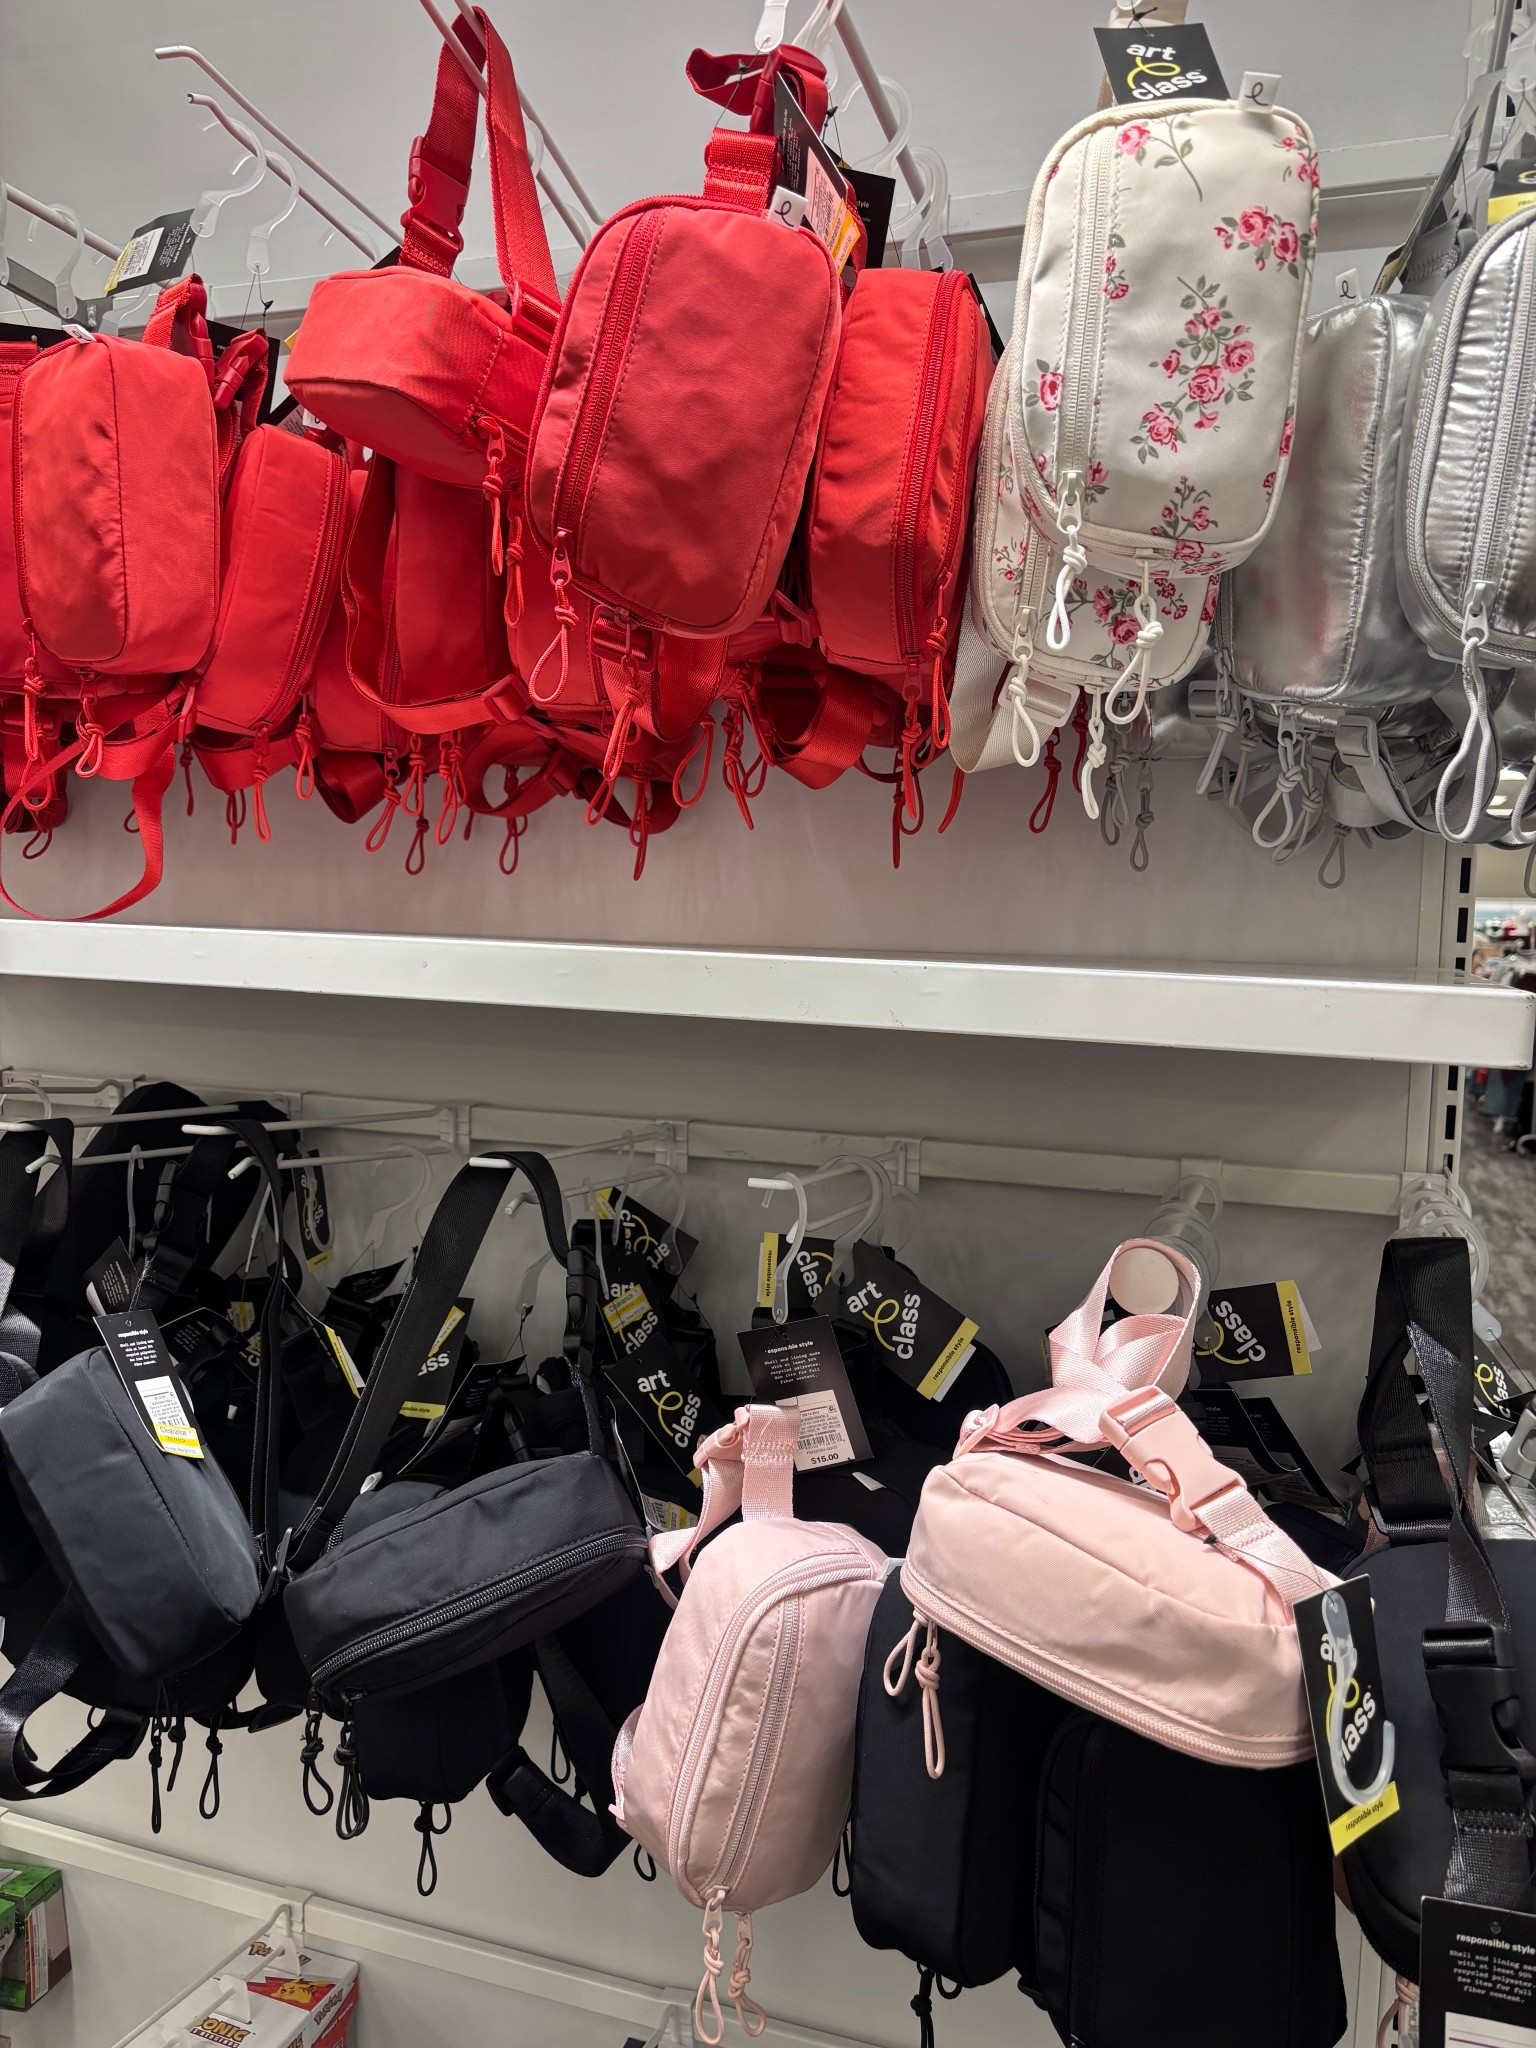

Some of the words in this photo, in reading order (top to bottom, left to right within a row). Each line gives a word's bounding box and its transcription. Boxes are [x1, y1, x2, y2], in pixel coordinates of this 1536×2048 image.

[1126, 44, 1176, 60] art
[1132, 71, 1208, 100] class
[646, 1243, 671, 1270] art
[796, 1250, 822, 1301] clas
[846, 1280, 883, 1313] art
[1286, 1300, 1294, 1316] style
[625, 1311, 659, 1355] class
[892, 1293, 921, 1360] class
[1215, 1300, 1266, 1362] class
[1292, 1316, 1302, 1354] responsible
[799, 1340, 814, 1349] style
[933, 1350, 956, 1381] responsible
[953, 1337, 965, 1351] style
[637, 1369, 671, 1393] art
[671, 1393, 701, 1448] class
[810, 1453, 839, 1465] $15.00
[1338, 1691, 1377, 1764] lass
[1345, 1806, 1372, 1832] responsible
[1371, 1799, 1384, 1814] style
[1456, 1933, 1511, 1951] responsible
[1511, 1943, 1536, 1955] style
[1457, 1960, 1476, 1968] with
[1475, 1954, 1489, 1962] and
[1493, 1956, 1520, 1969] lining
[1514, 1987, 1532, 1996] full
[197, 2016, 252, 2043] ONIC
